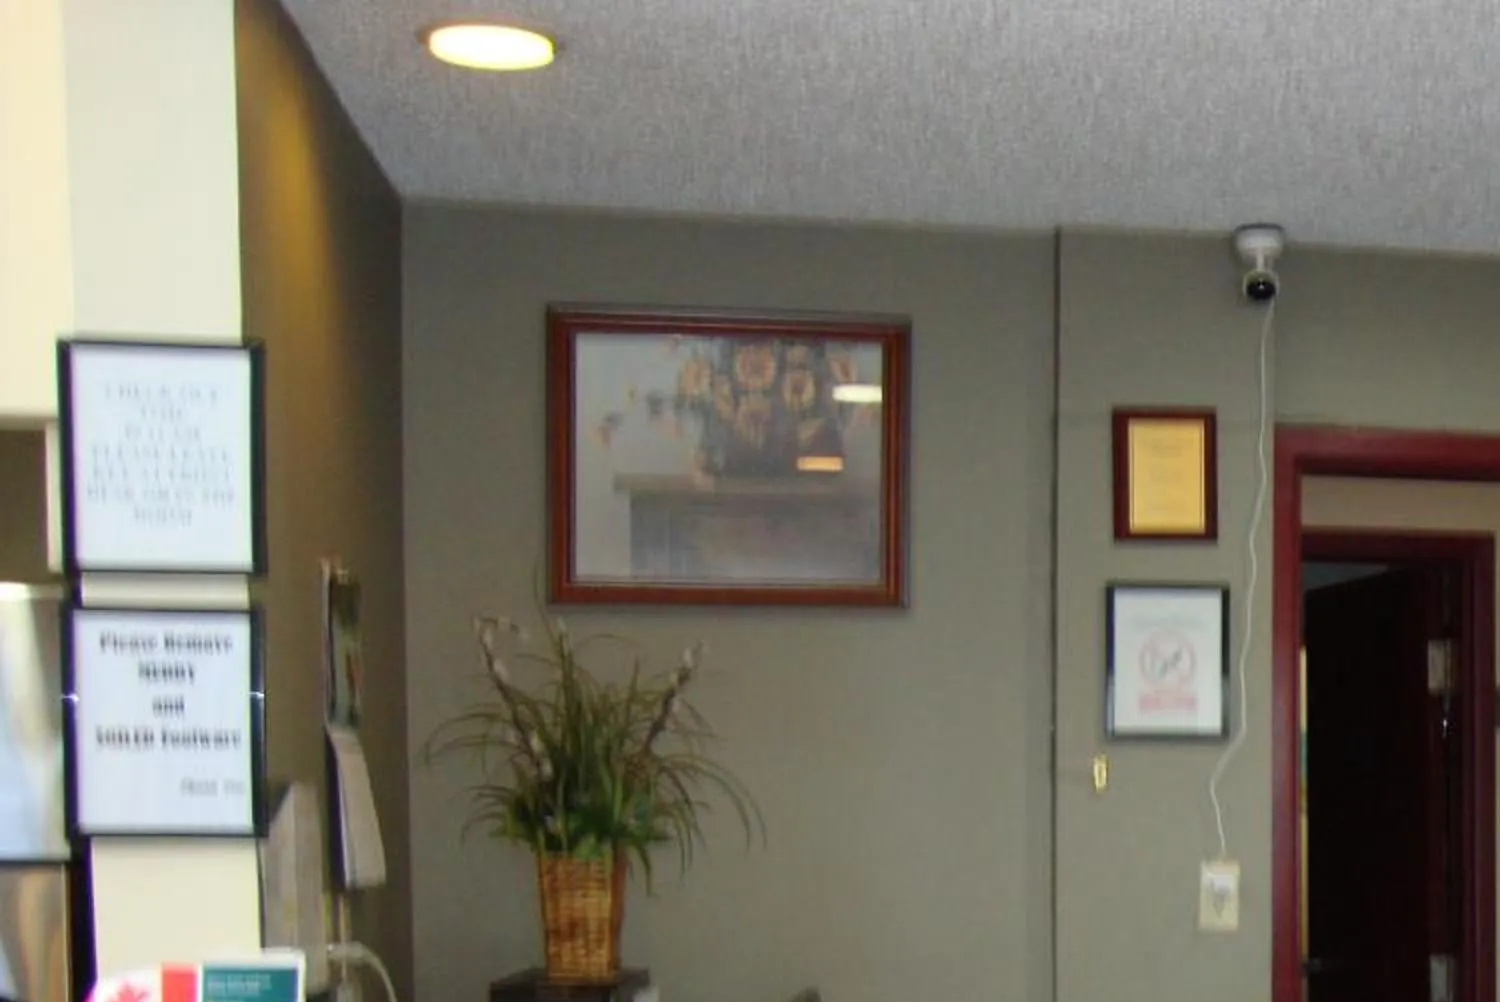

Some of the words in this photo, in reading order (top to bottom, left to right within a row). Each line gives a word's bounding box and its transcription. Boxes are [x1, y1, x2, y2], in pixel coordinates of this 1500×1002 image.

[99, 631, 158, 654] Please
[163, 632, 233, 655] Remove
[152, 696, 185, 717] and
